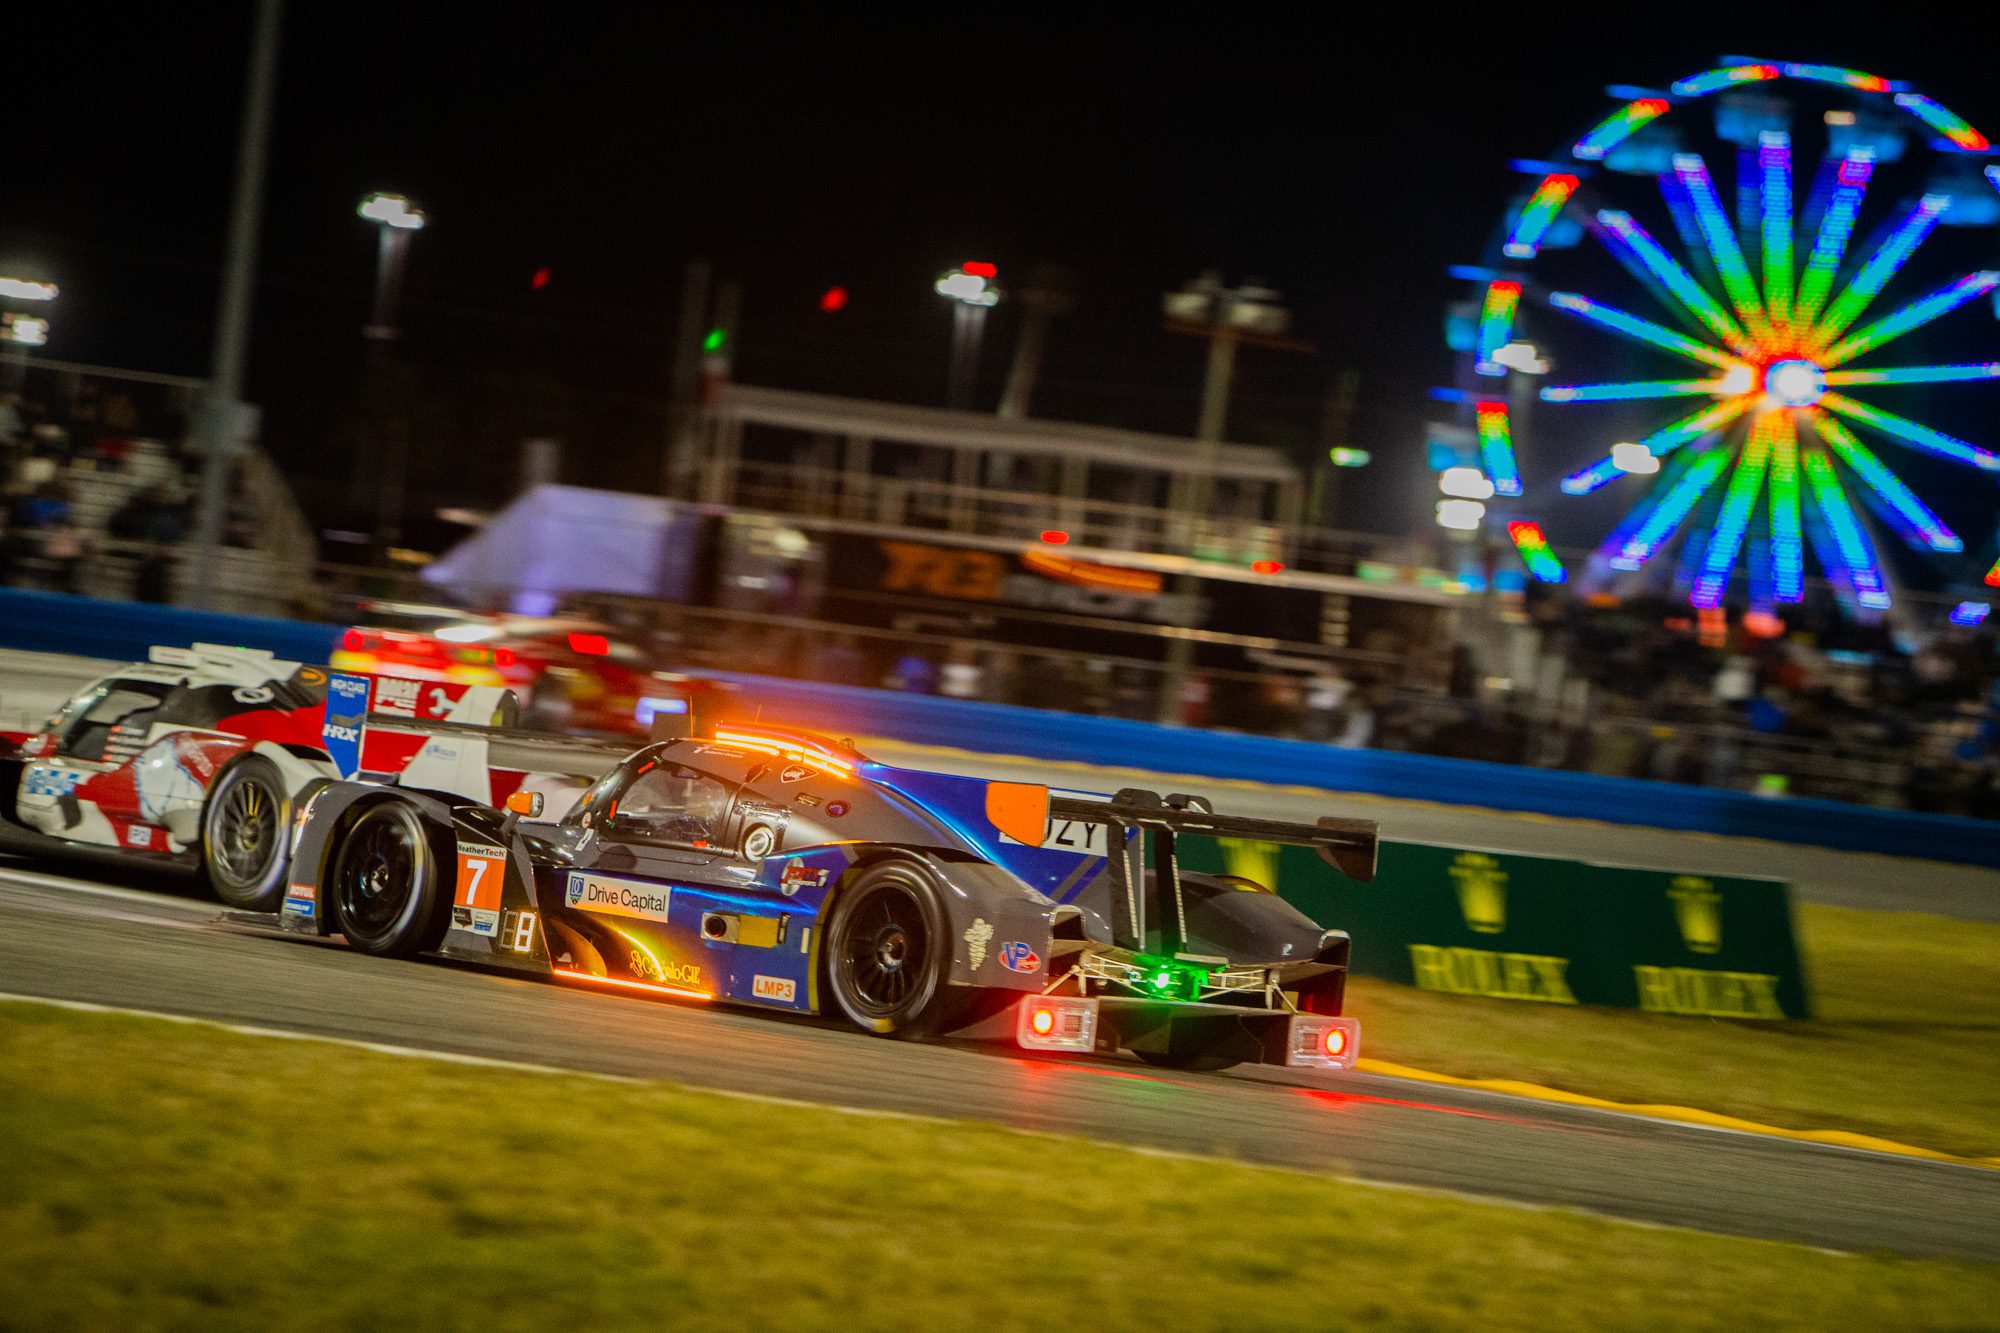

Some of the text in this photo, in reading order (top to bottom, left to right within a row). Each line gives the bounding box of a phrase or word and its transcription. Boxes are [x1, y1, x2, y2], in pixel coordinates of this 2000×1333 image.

[321, 724, 359, 742] HRX
[466, 858, 488, 905] 7
[588, 883, 667, 912] Drive Capital
[755, 978, 793, 998] LMP3
